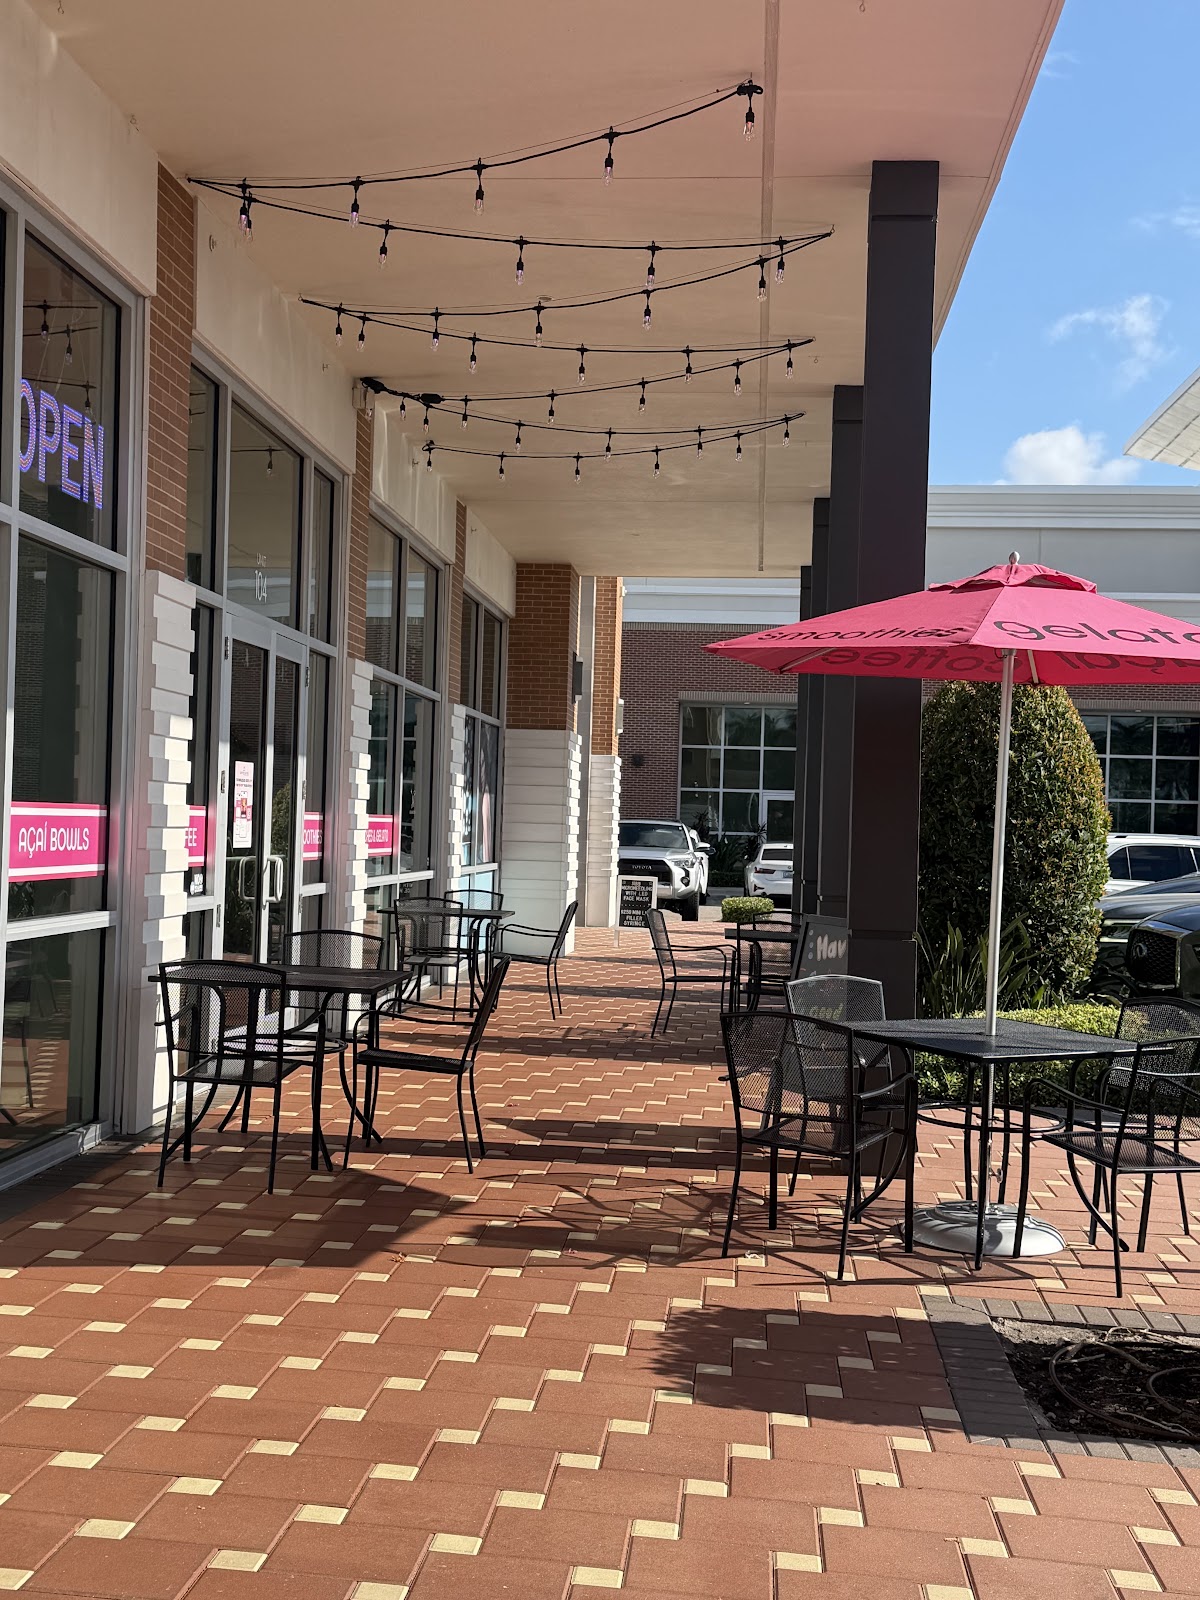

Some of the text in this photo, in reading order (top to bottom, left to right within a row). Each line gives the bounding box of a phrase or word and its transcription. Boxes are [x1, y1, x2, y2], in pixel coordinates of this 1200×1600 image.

[19, 379, 104, 510] OPEN
[255, 570, 267, 603] 104
[757, 626, 966, 642] smoothies
[18, 821, 90, 859] AÇAÍ BOWLS
